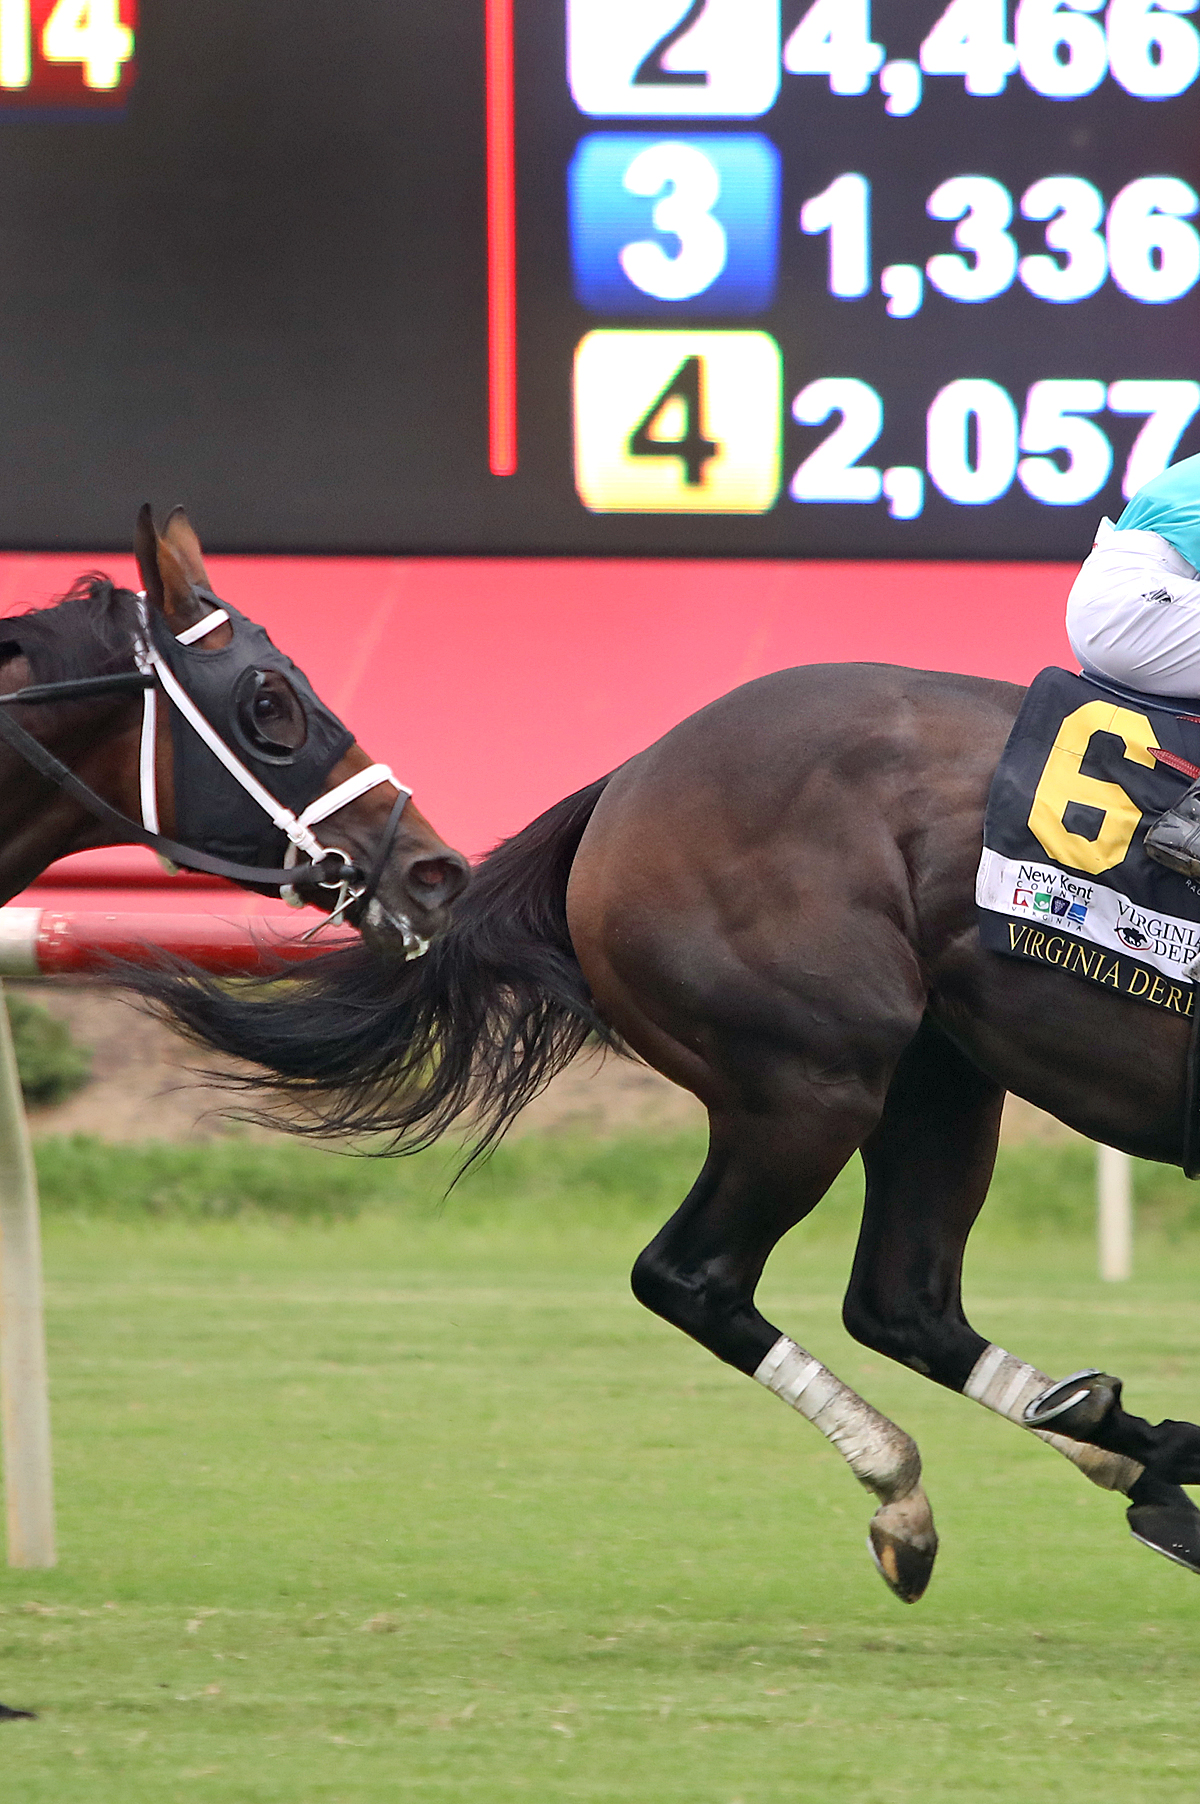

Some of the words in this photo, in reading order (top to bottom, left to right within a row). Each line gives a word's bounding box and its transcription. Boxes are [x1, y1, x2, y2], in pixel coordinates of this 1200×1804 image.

[629, 0, 712, 87] 2
[620, 141, 727, 300] 3
[627, 354, 720, 490] 4
[1027, 700, 1162, 875] 6
[1012, 906, 1082, 932] VIRGINIA
[1017, 880, 1090, 906] COUNTY
[1018, 865, 1057, 885] New
[1060, 875, 1094, 900] Kent
[1008, 923, 1120, 988] VIRGINIA
